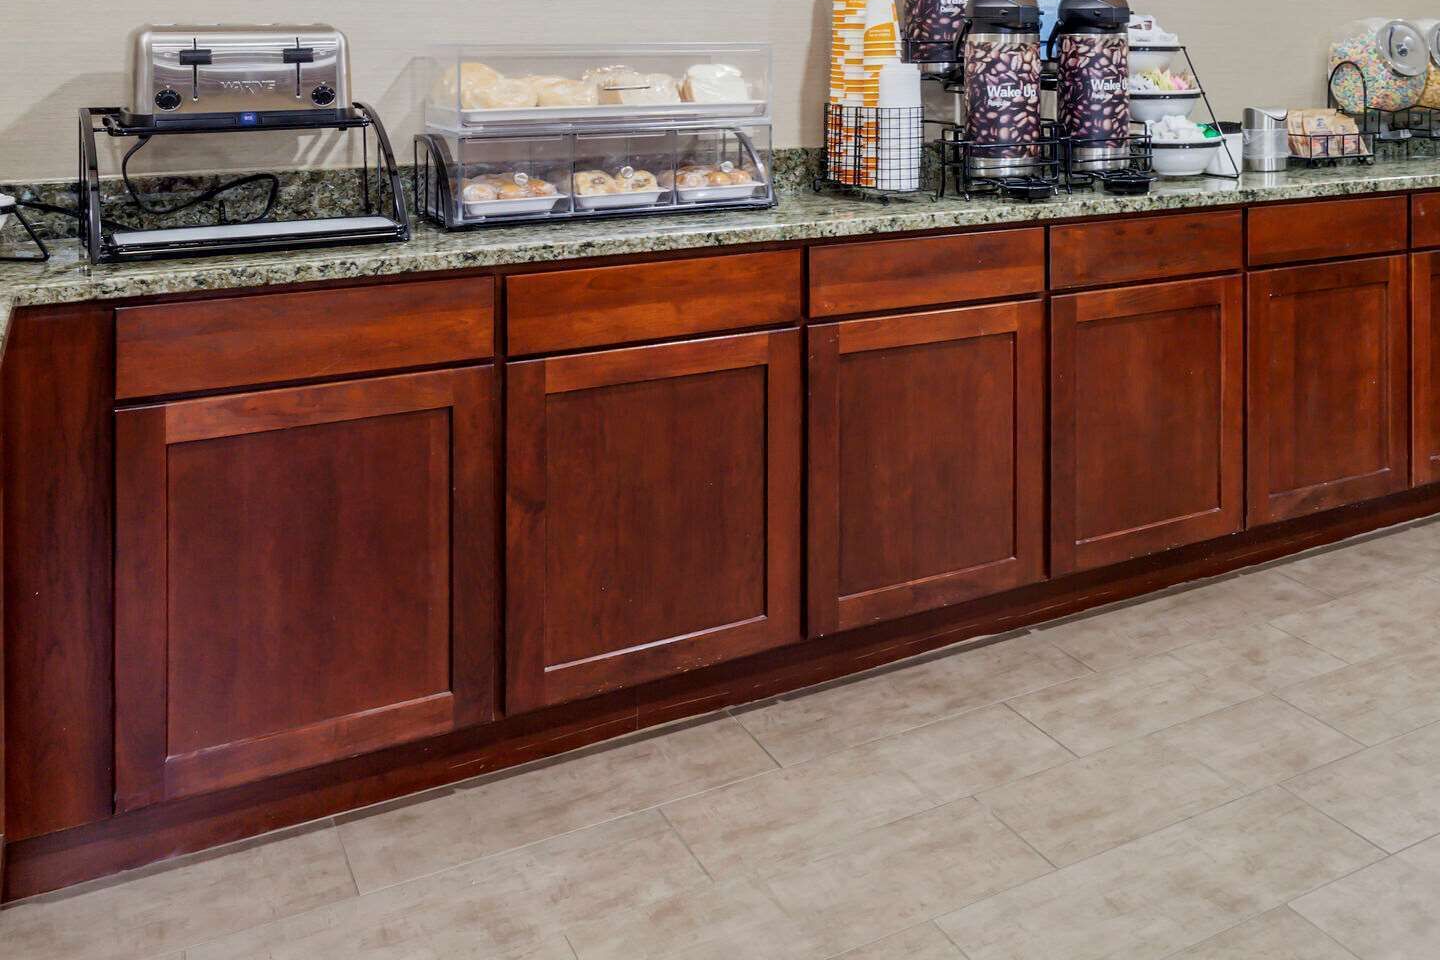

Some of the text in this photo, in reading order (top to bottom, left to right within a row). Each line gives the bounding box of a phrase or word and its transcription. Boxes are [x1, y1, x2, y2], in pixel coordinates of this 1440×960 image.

[1091, 79, 1121, 91] Wake
[986, 84, 1037, 101] Wake Up
